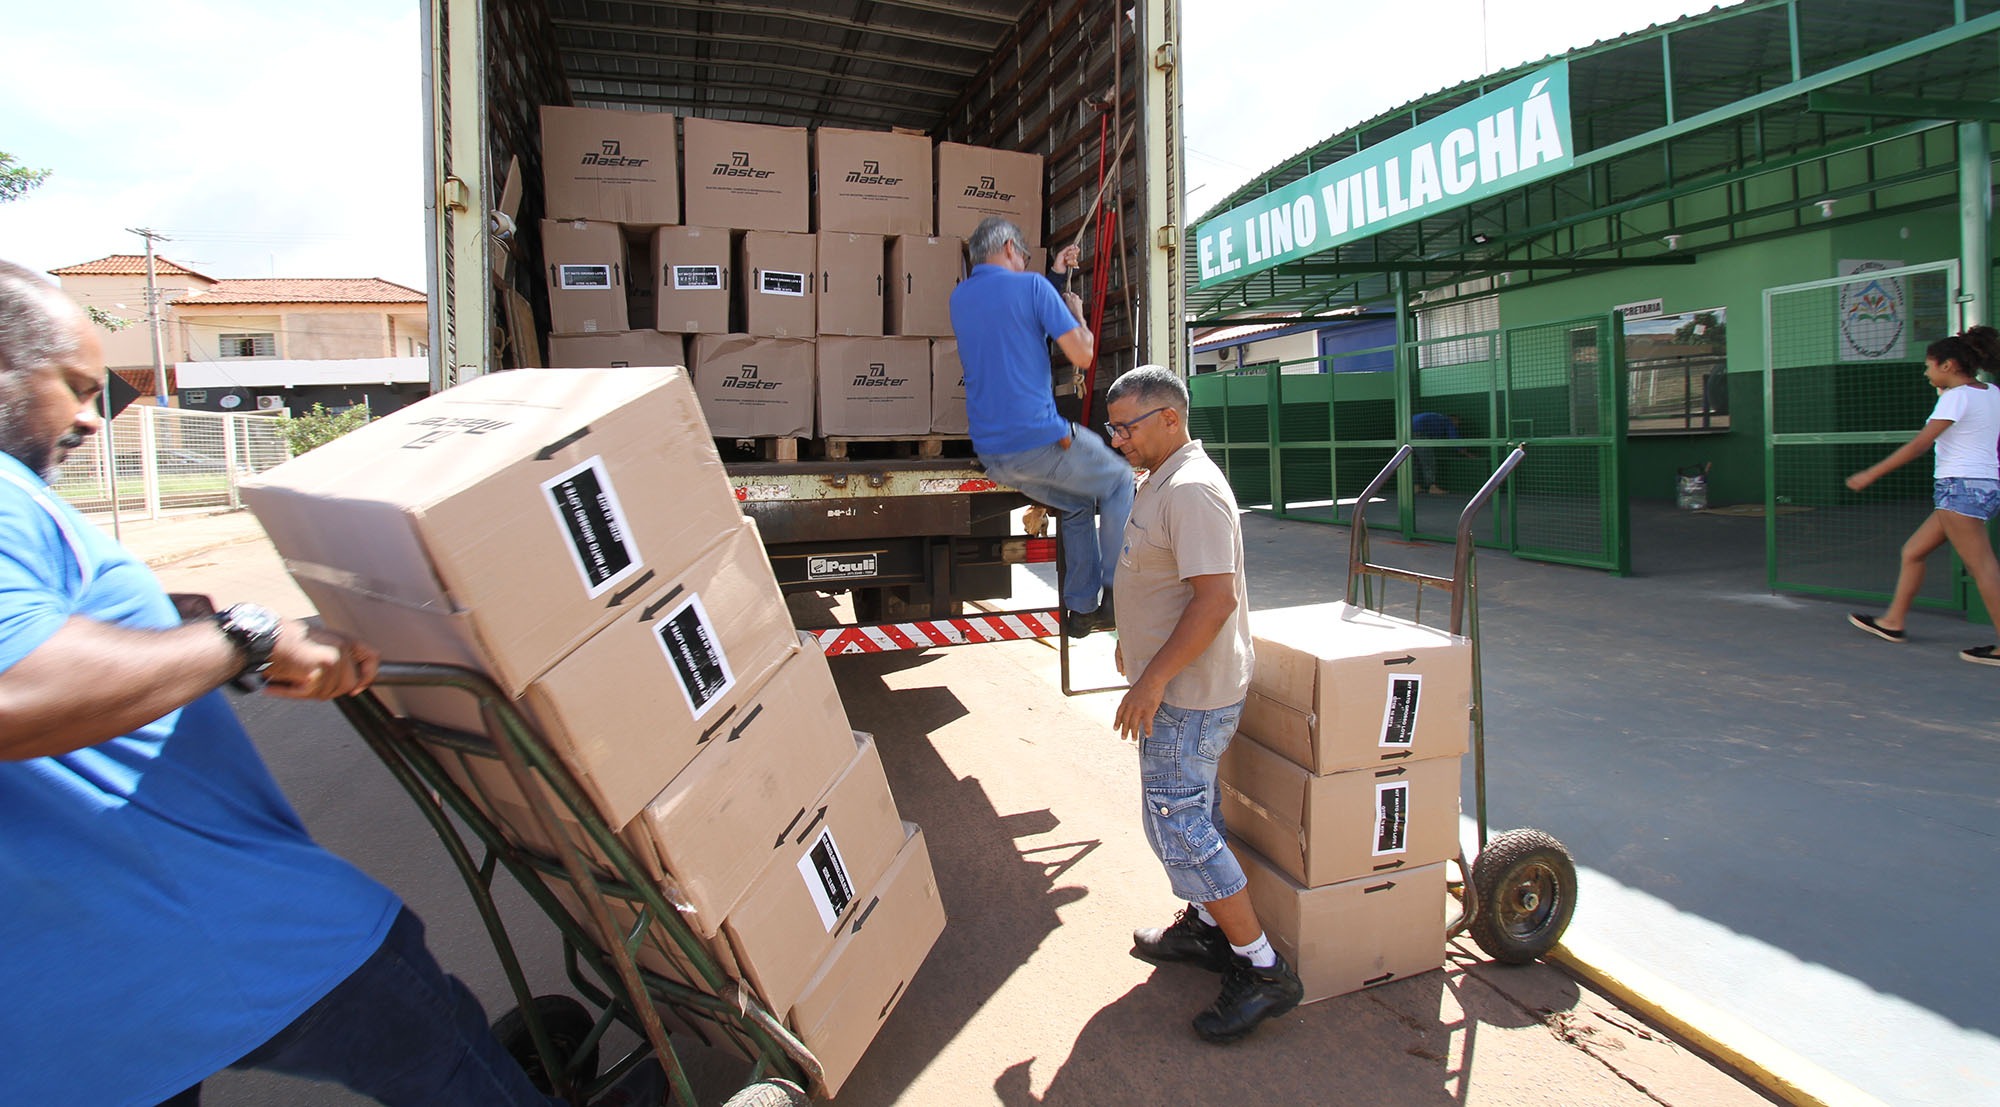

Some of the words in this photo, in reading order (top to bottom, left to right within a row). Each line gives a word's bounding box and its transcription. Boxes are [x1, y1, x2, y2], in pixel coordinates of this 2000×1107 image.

[1199, 227, 1242, 281] E.E.
[1245, 194, 1317, 264] LINO
[1321, 77, 1564, 237] VILLACHÁ
[1615, 302, 1661, 316] CRETARIA
[827, 559, 875, 573] Pauli
